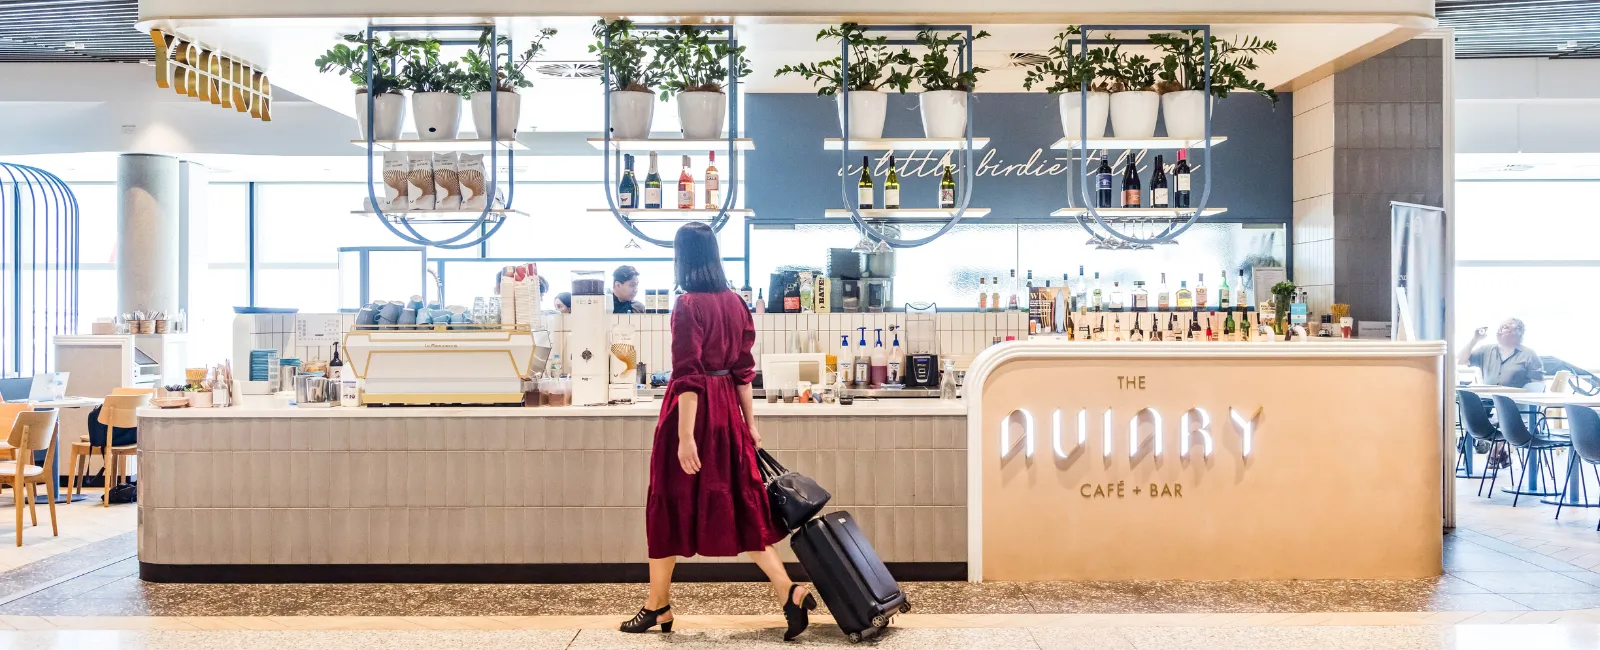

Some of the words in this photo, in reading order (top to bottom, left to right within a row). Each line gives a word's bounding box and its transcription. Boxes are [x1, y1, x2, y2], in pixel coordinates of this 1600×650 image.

[974, 148, 1067, 177] birdie
[1029, 292, 1050, 300] WIN
[1117, 375, 1146, 389] THE
[1080, 480, 1125, 498] CAFÉ
[1132, 486, 1142, 496] +
[1150, 483, 1183, 498] BAR
